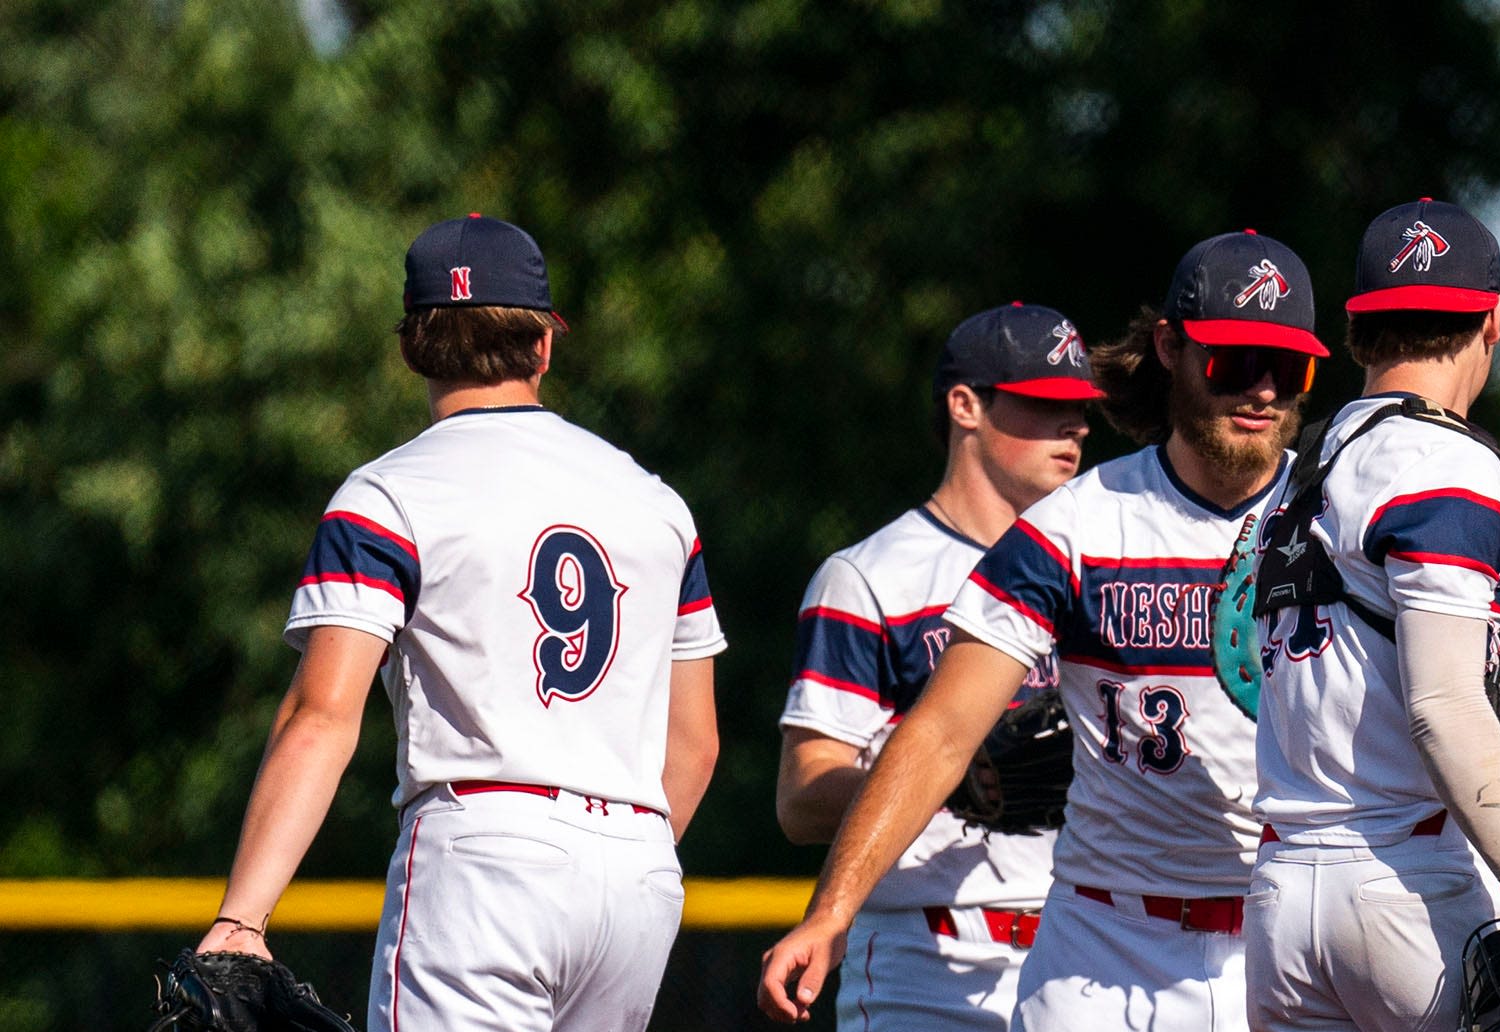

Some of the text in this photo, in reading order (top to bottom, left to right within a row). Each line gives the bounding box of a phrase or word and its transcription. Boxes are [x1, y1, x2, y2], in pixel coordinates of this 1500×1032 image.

[450, 266, 472, 301] N
[517, 524, 629, 709] 9
[1097, 679, 1192, 776] 13
